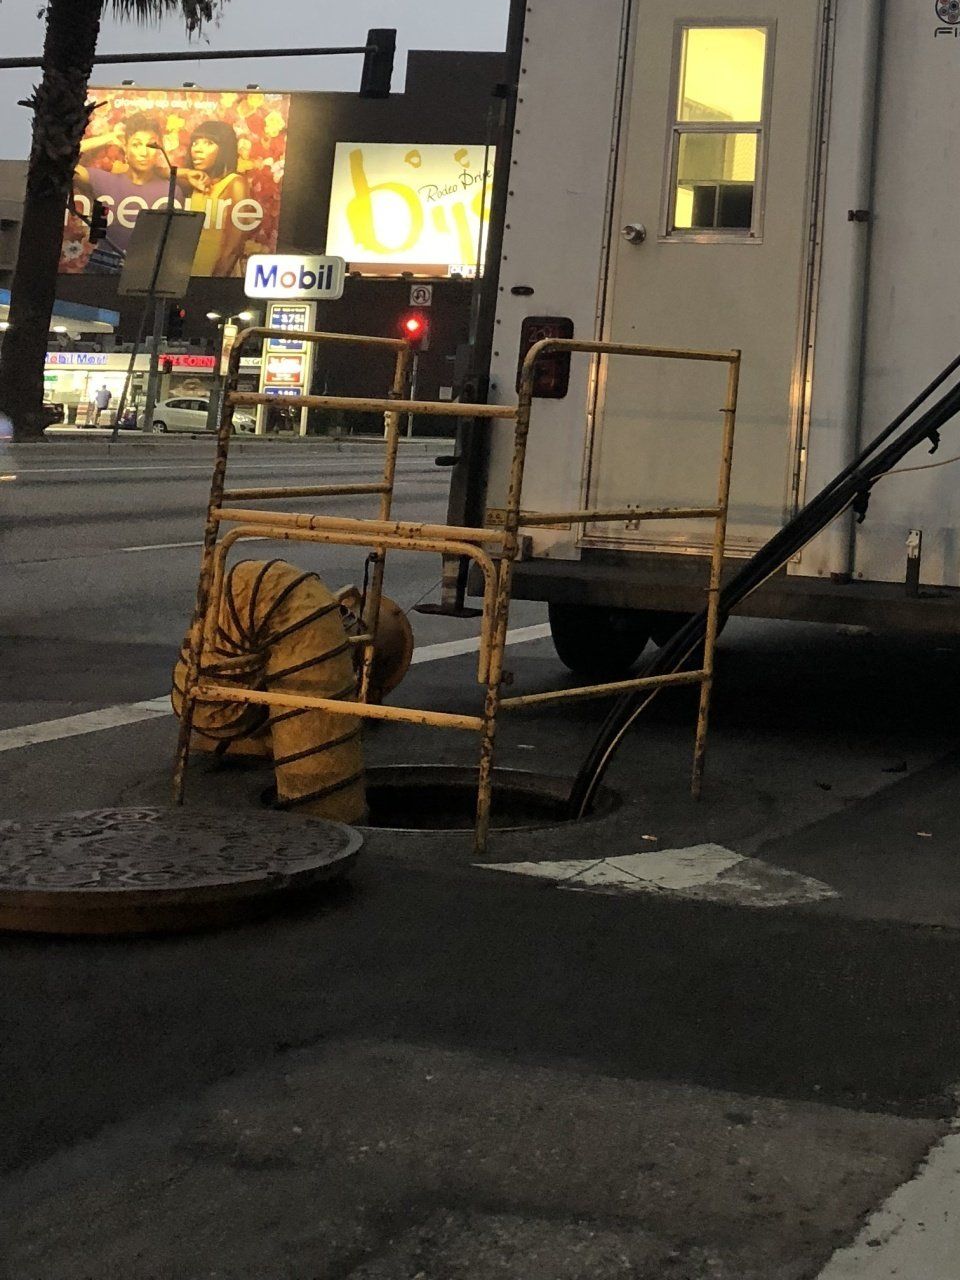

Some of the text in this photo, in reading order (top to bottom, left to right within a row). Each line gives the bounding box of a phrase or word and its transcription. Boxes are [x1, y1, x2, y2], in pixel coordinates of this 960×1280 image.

[418, 168, 493, 202] Rodeo Drie
[253, 264, 334, 291] Mobil
